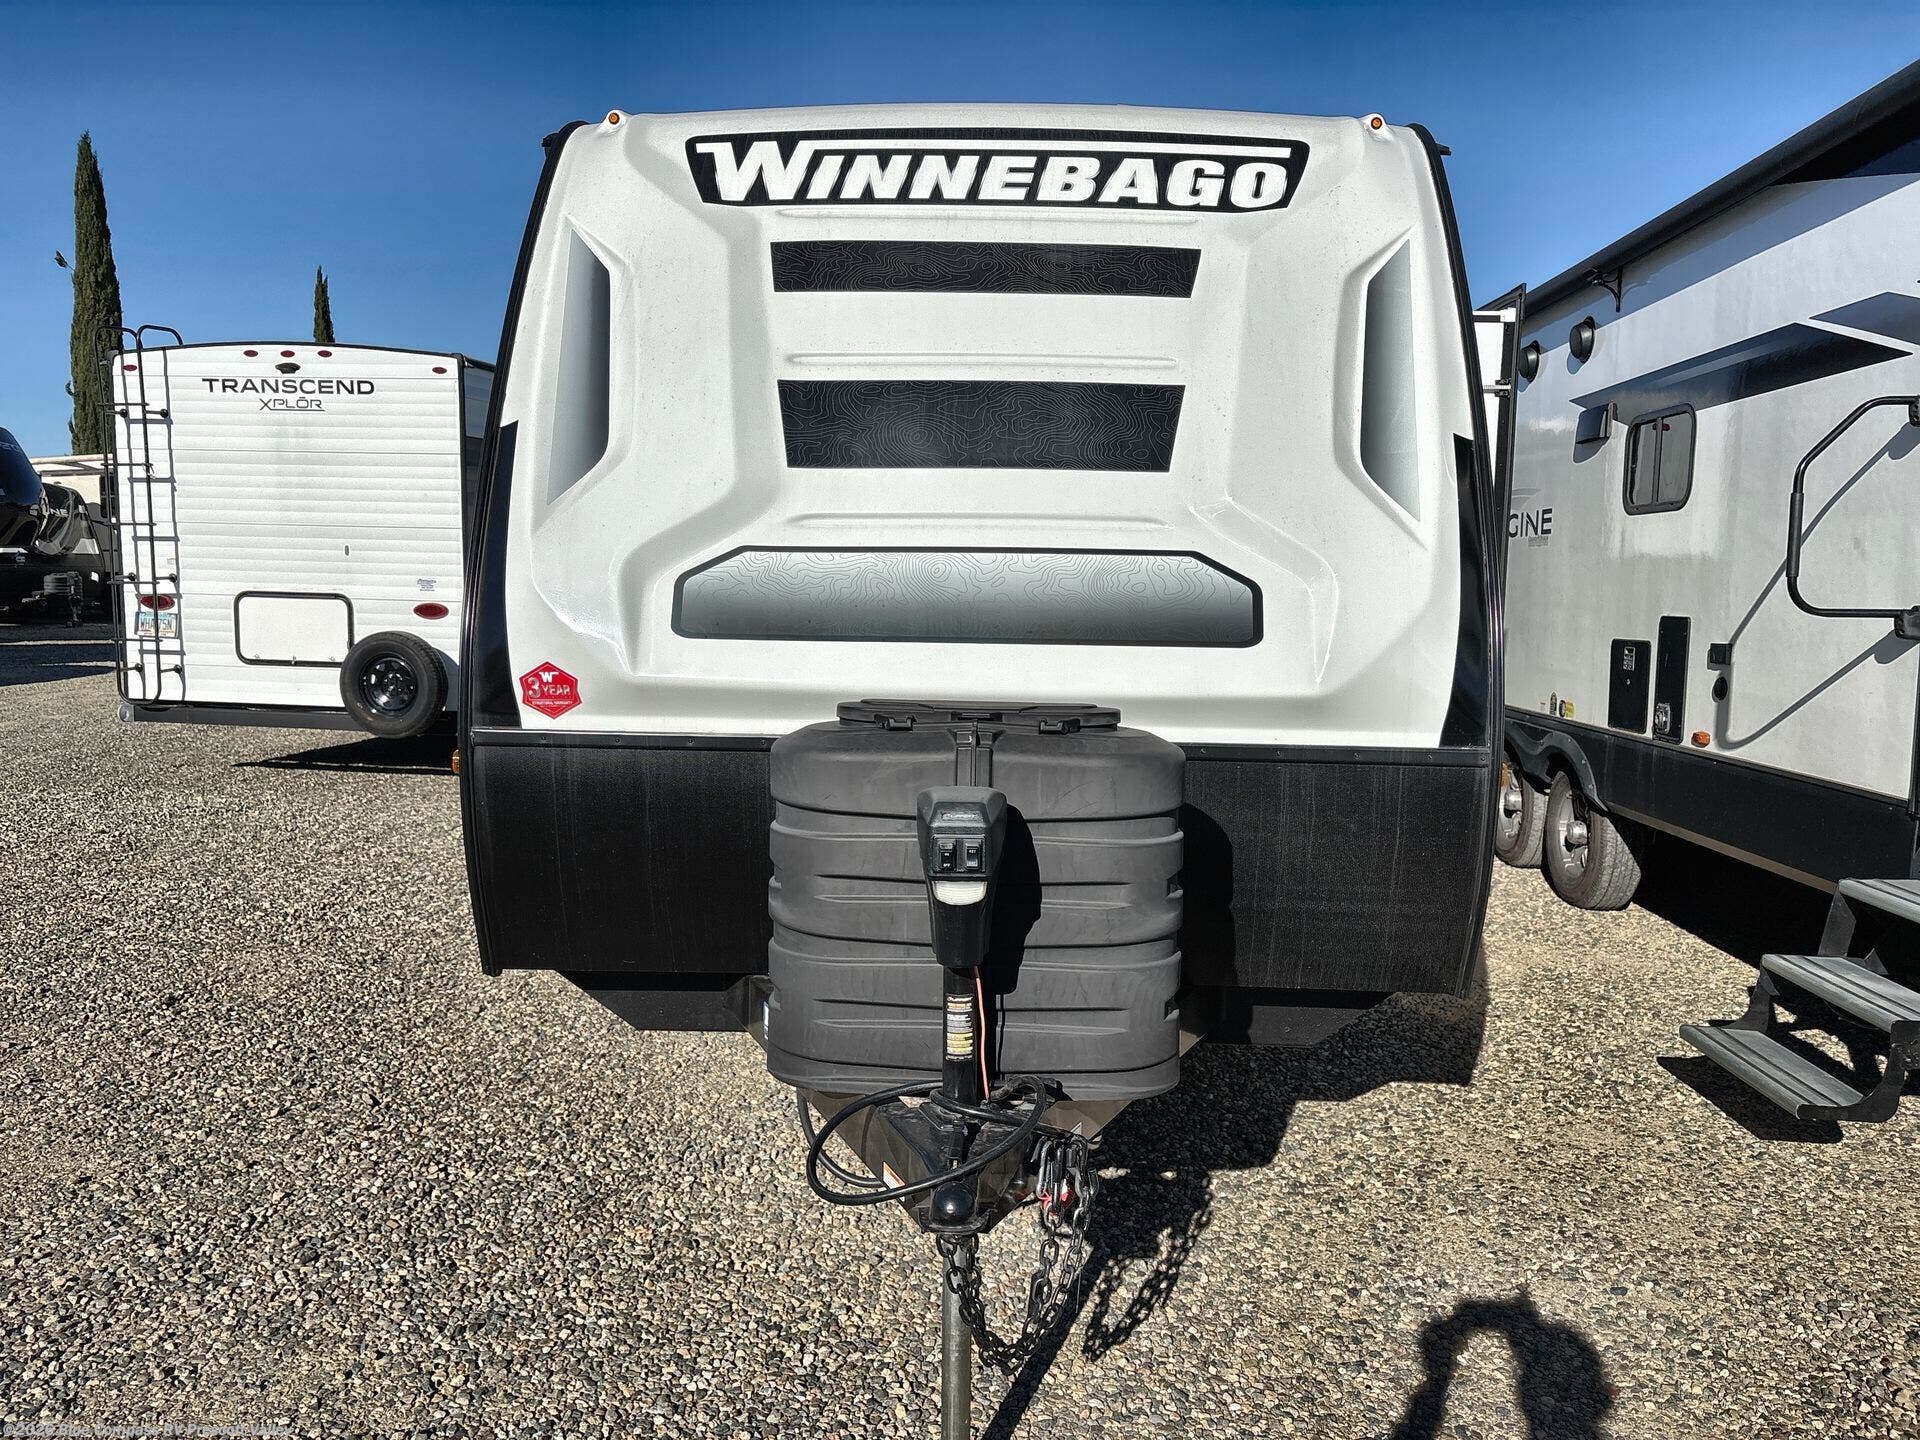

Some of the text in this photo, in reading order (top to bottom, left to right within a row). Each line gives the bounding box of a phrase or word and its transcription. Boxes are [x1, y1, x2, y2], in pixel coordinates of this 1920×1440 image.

[696, 139, 1291, 208] WINNEBAGO
[201, 378, 375, 395] TRANSCEND
[527, 676, 571, 699] 3 YEAR
